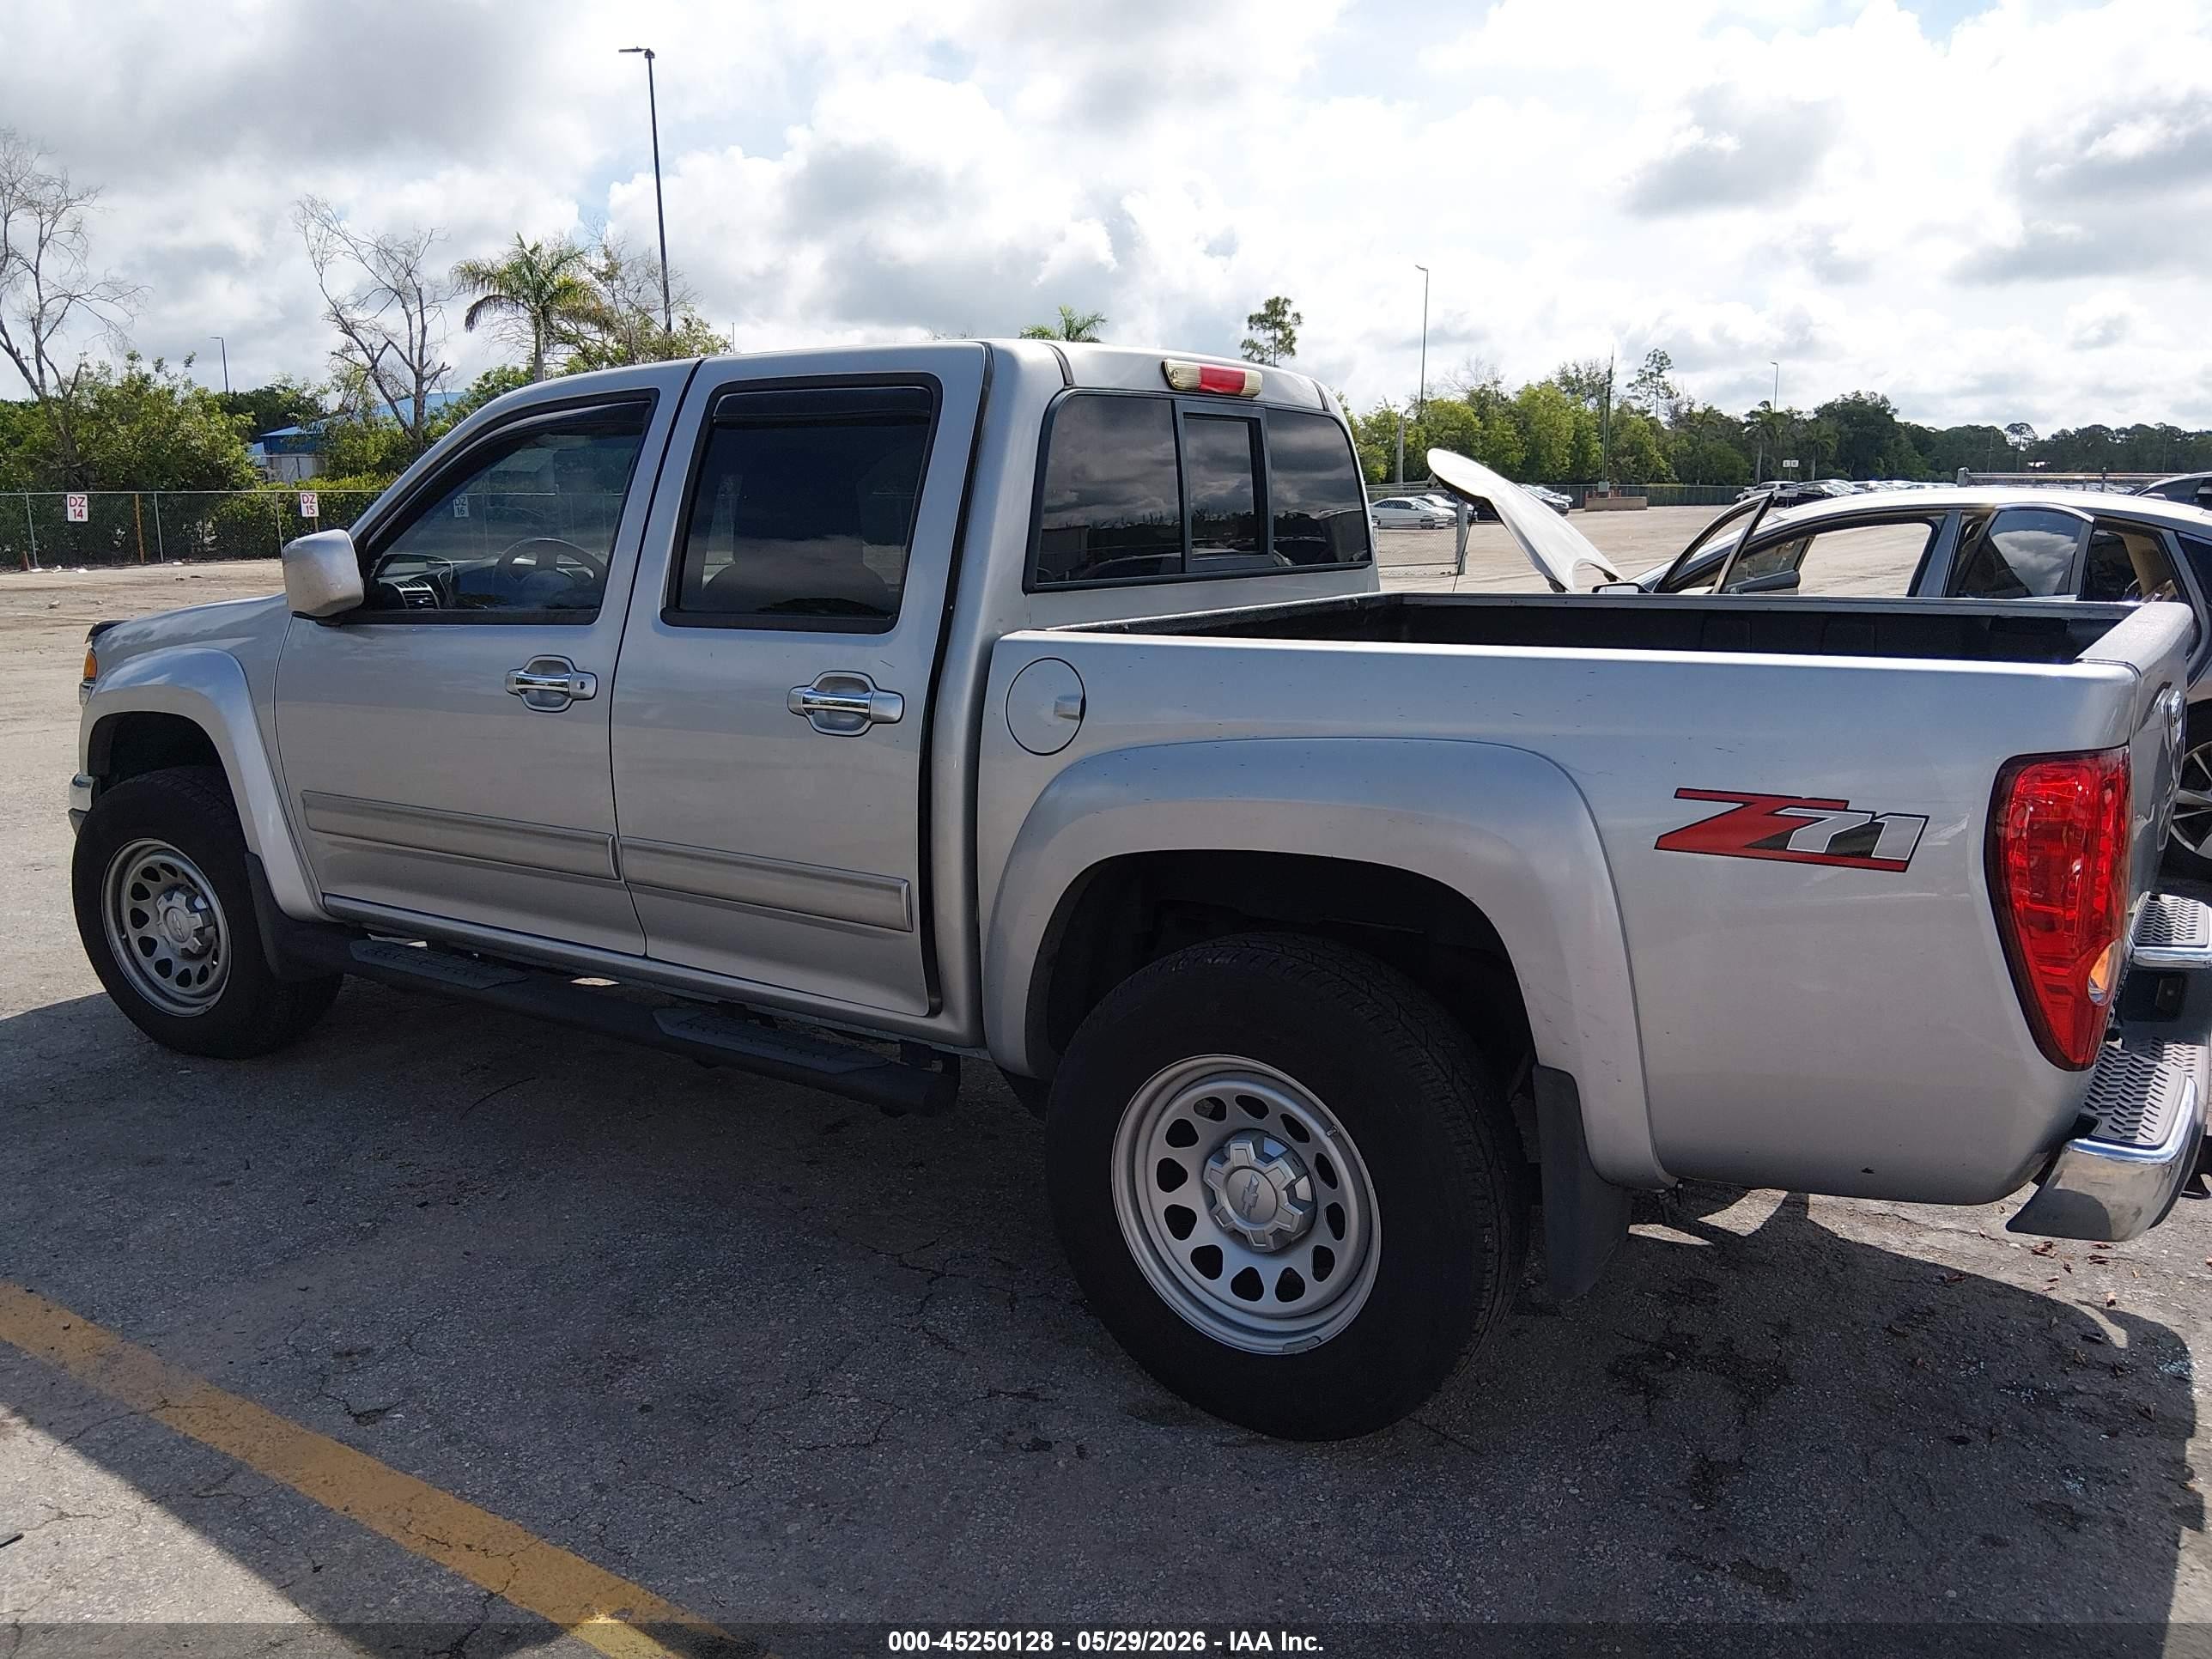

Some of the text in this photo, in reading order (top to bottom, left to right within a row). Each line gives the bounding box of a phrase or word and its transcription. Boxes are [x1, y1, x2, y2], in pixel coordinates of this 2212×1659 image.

[69, 496, 86, 507] DZ
[301, 495, 316, 504] DZ
[73, 508, 83, 520] 14
[307, 505, 315, 515] 15
[1654, 787, 1929, 872] Z71
